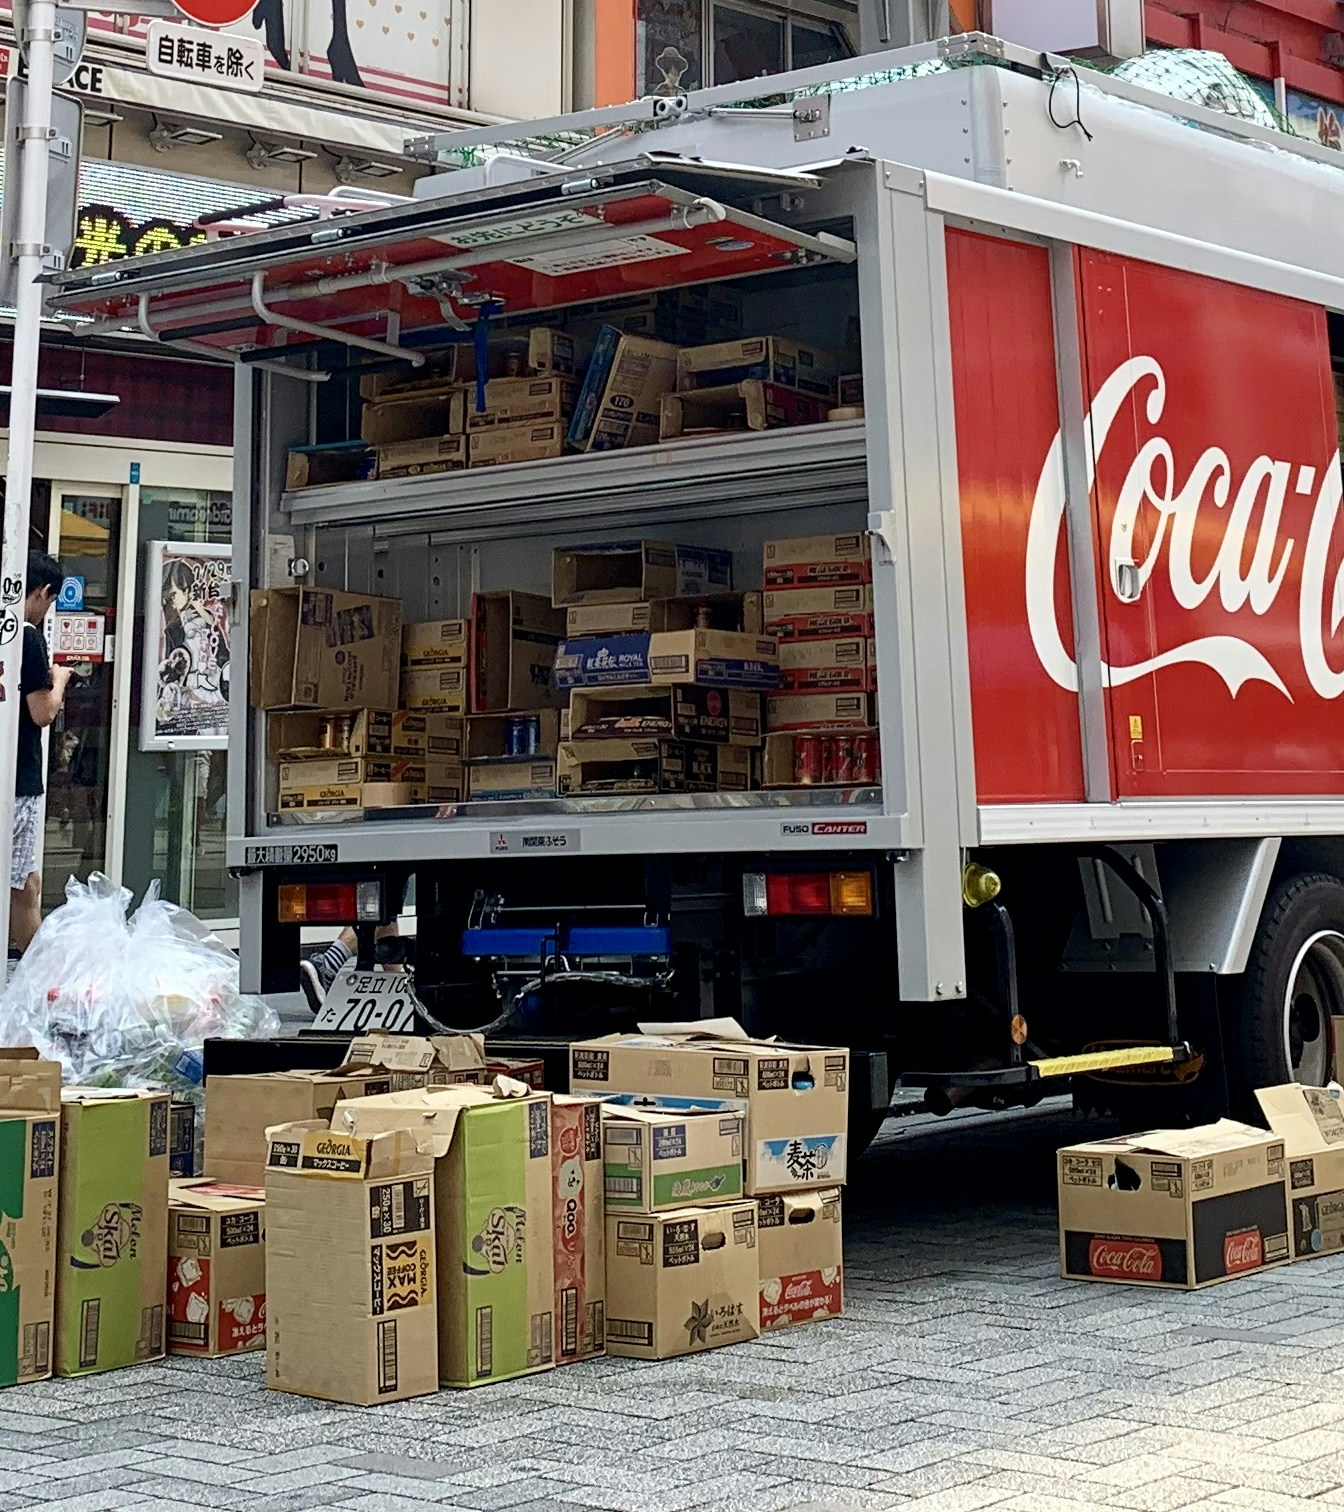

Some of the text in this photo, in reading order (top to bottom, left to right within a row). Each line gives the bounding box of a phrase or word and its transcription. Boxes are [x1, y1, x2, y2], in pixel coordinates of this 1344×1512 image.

[157, 35, 255, 82] 自転車を除く
[782, 821, 867, 835] FUSO CANTER
[354, 976, 386, 995] 足立
[320, 1008, 337, 1024] た
[315, 1138, 353, 1158] GEORGIA
[785, 1139, 817, 1181] 麦茶
[1092, 1244, 1159, 1275] Coca-Cola
